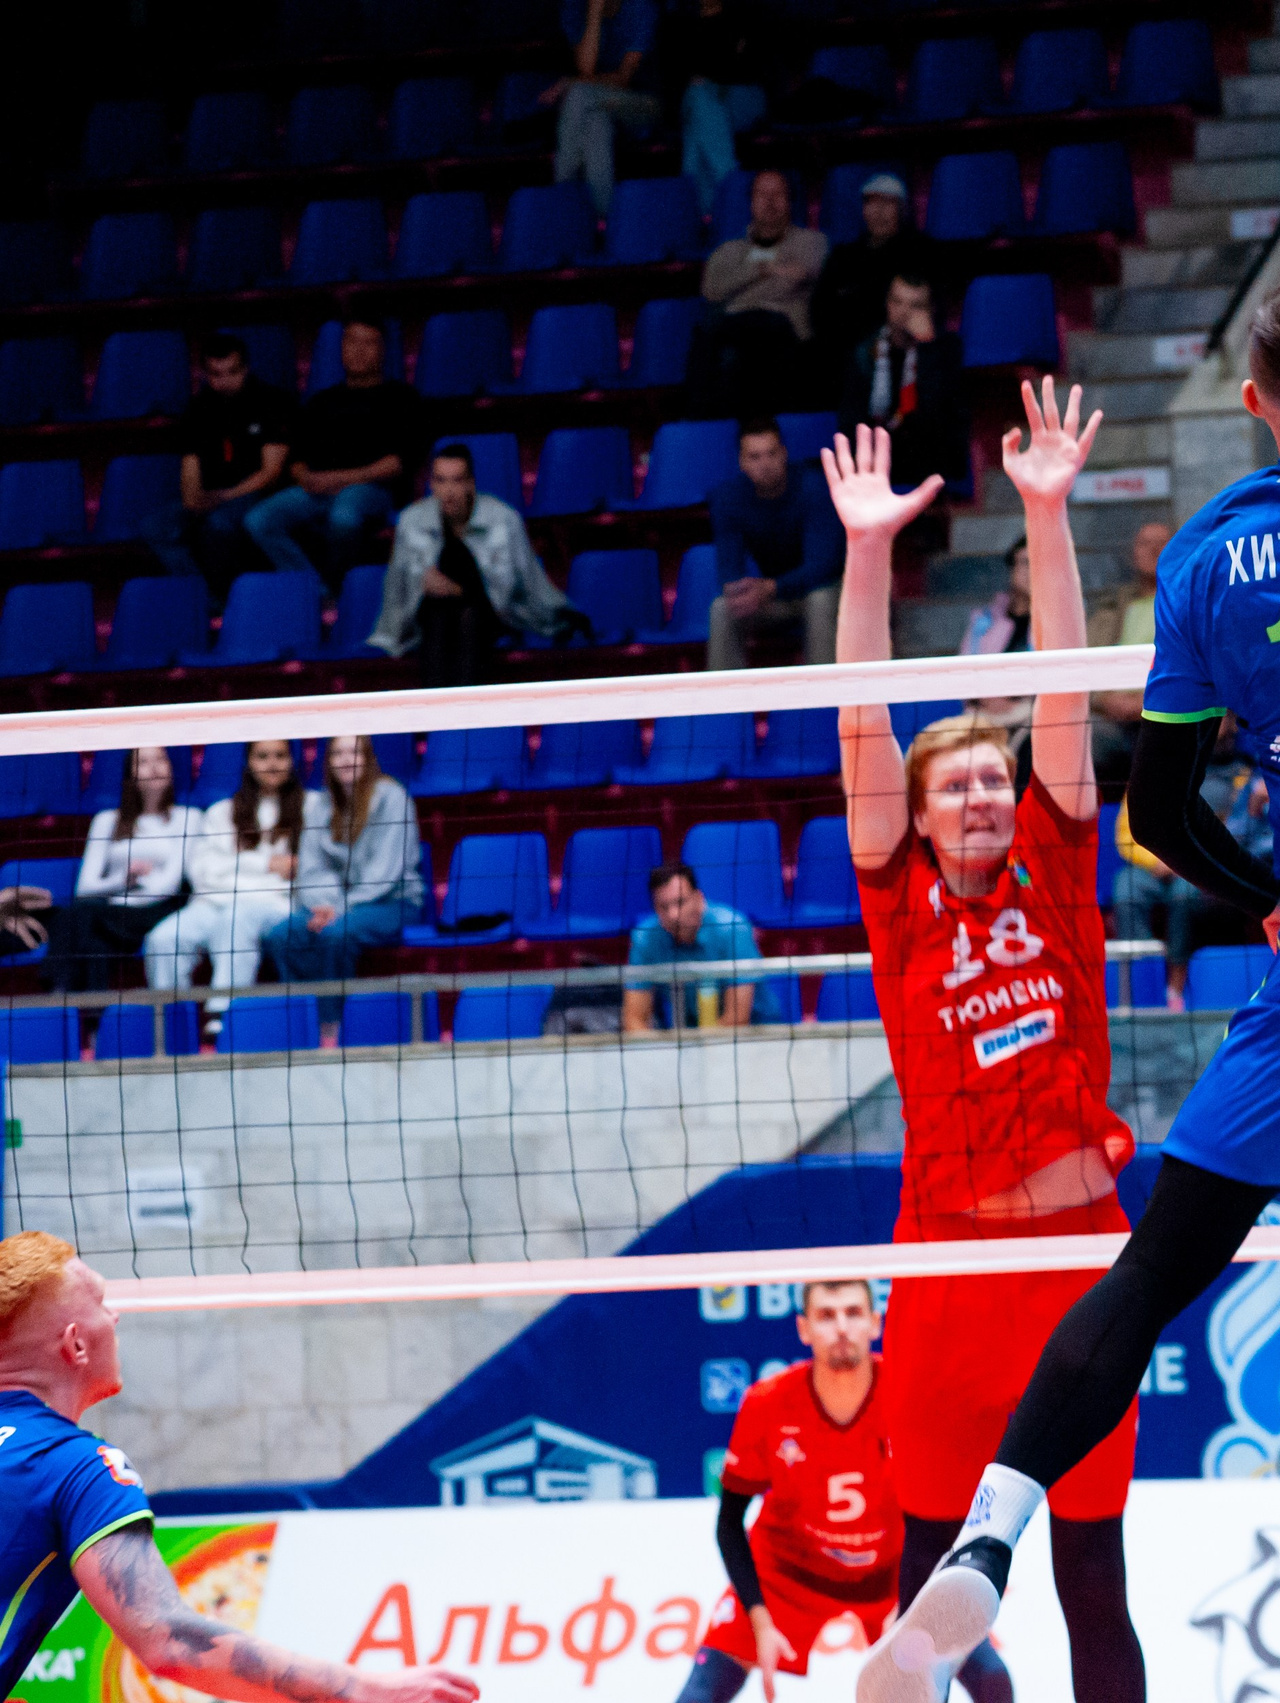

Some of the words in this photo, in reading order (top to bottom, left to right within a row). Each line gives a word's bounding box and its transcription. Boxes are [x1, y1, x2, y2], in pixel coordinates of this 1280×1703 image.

[942, 907, 1045, 990] 18
[938, 975, 1064, 1032] ТЮМЕНЬ
[826, 1471, 867, 1523] 5
[346, 1575, 702, 1687] Альфа
